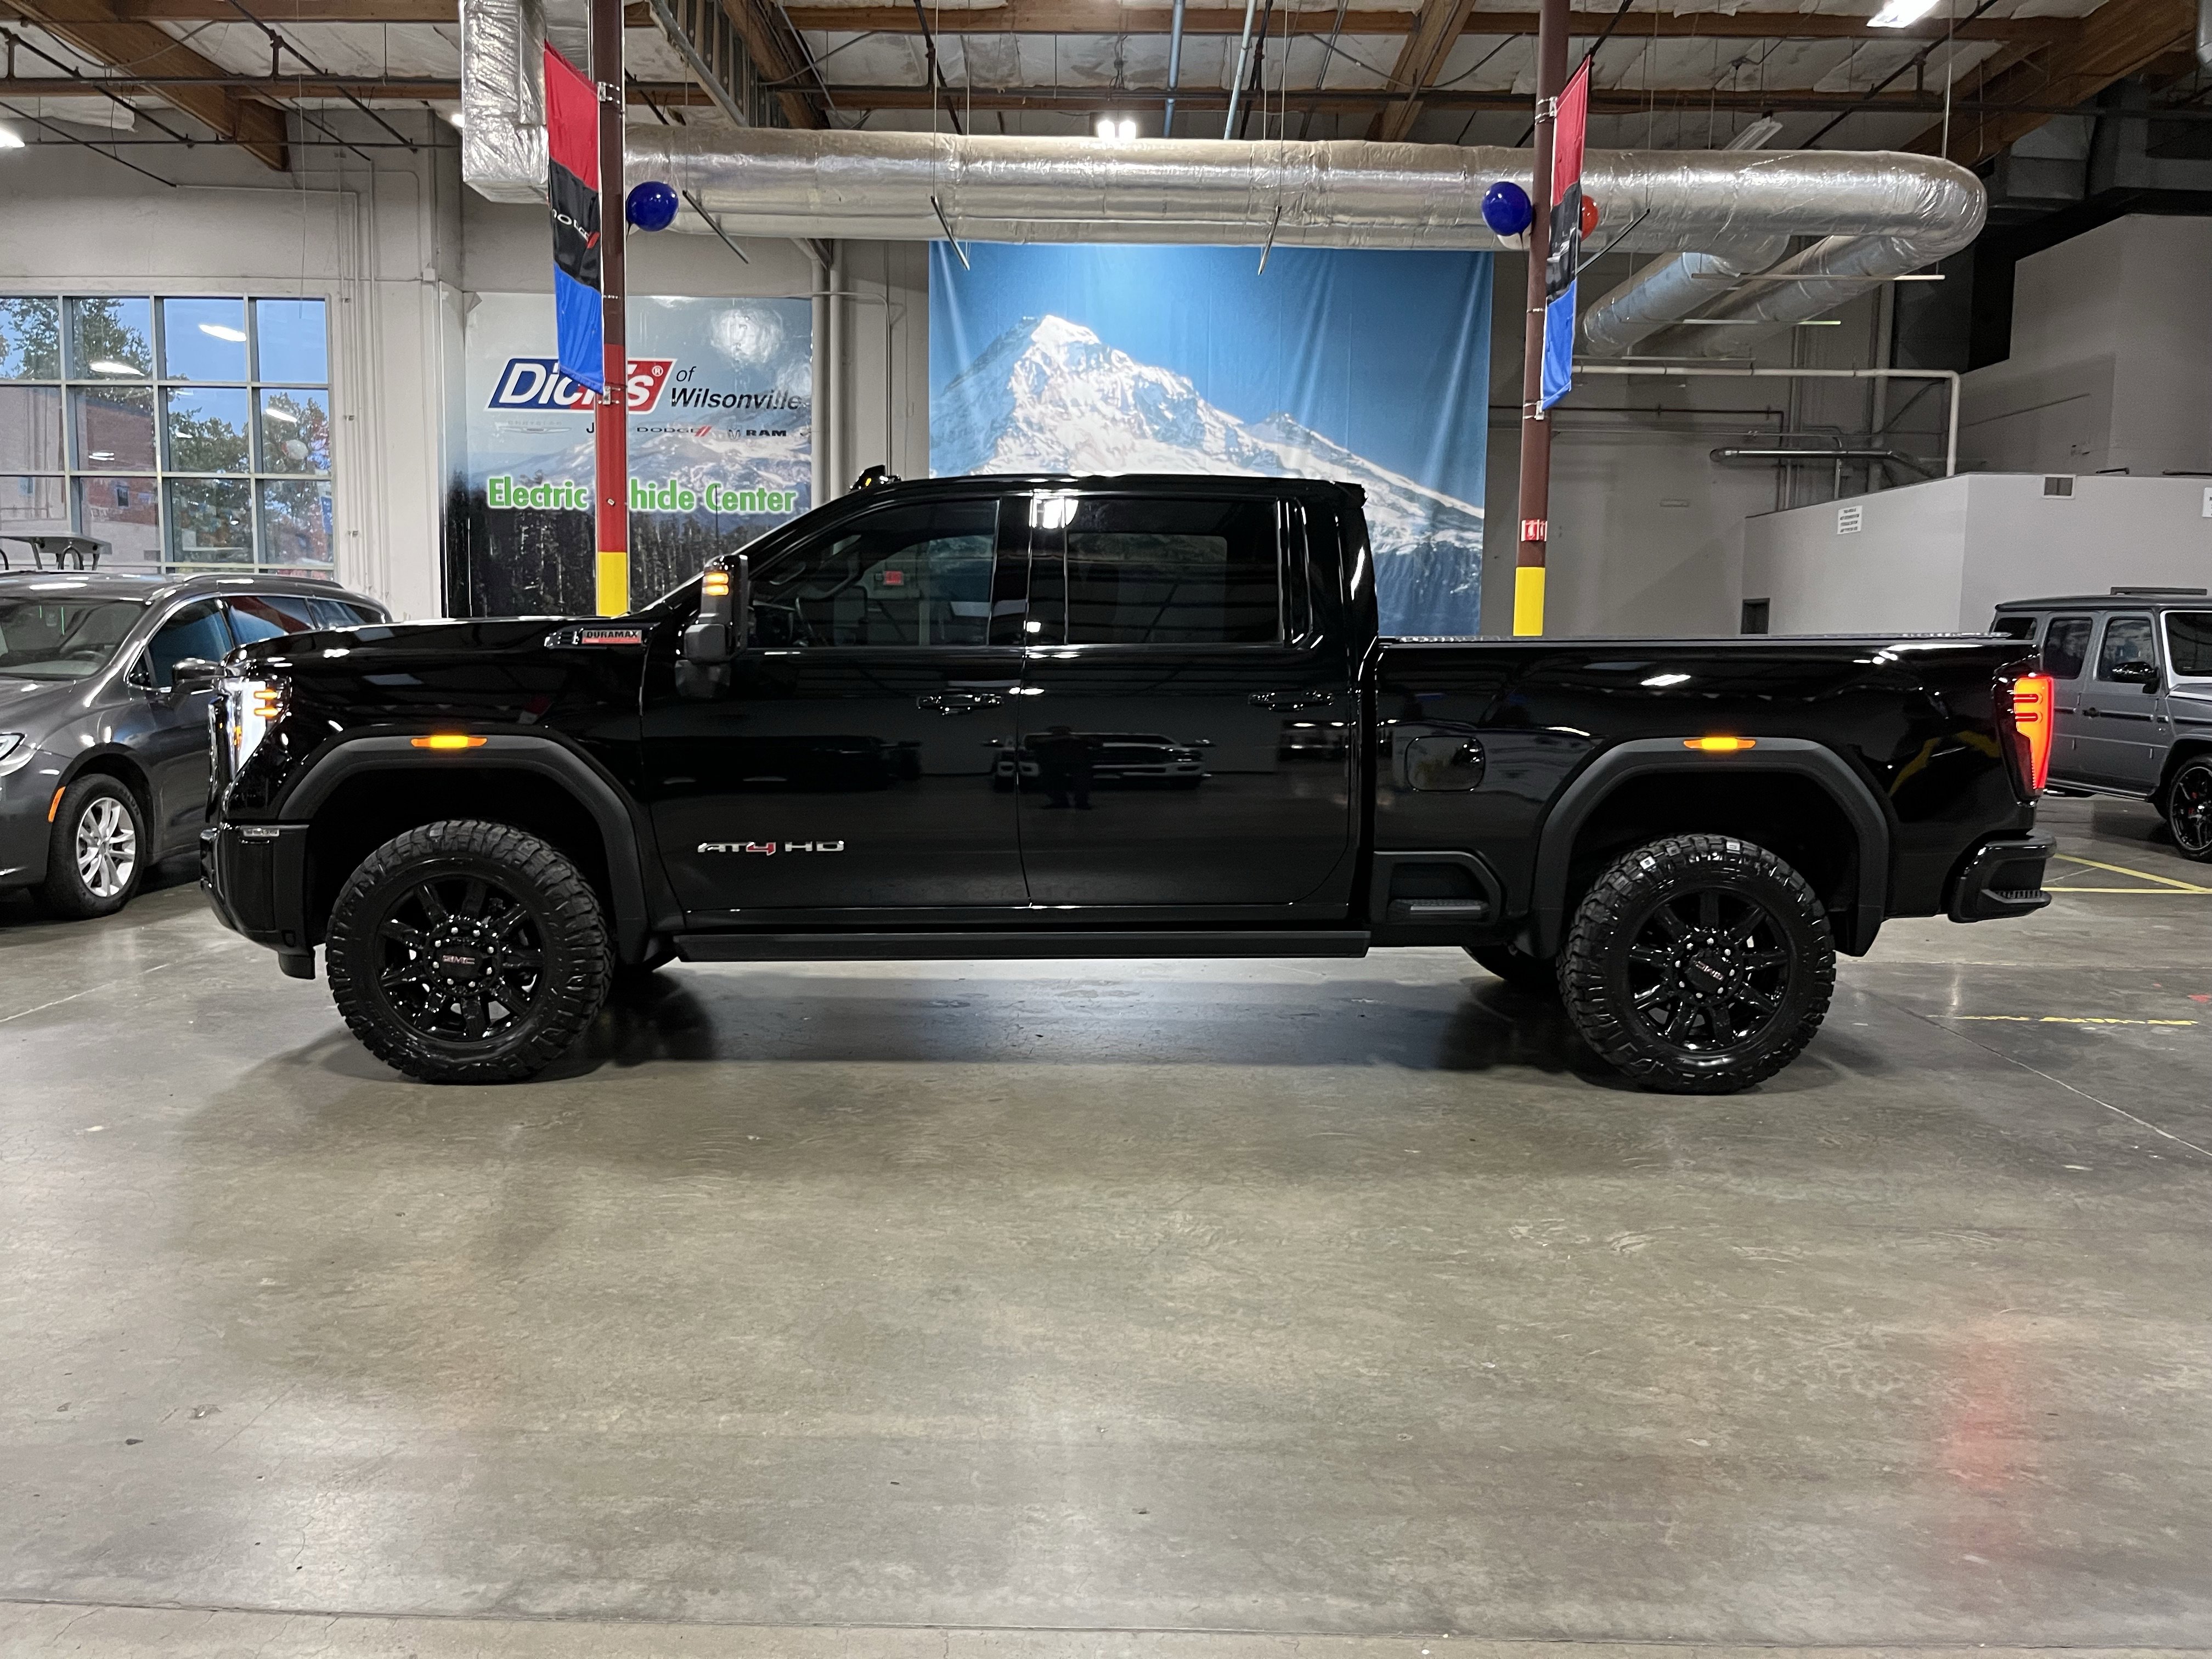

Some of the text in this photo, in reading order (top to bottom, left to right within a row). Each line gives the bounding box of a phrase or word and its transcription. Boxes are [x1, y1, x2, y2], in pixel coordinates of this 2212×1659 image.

[676, 366, 697, 382] of
[670, 387, 803, 410] Wilsonville
[488, 476, 796, 512] Electric hicle Center
[586, 630, 638, 639] DURAMAX
[697, 841, 844, 856] AT4 HD
